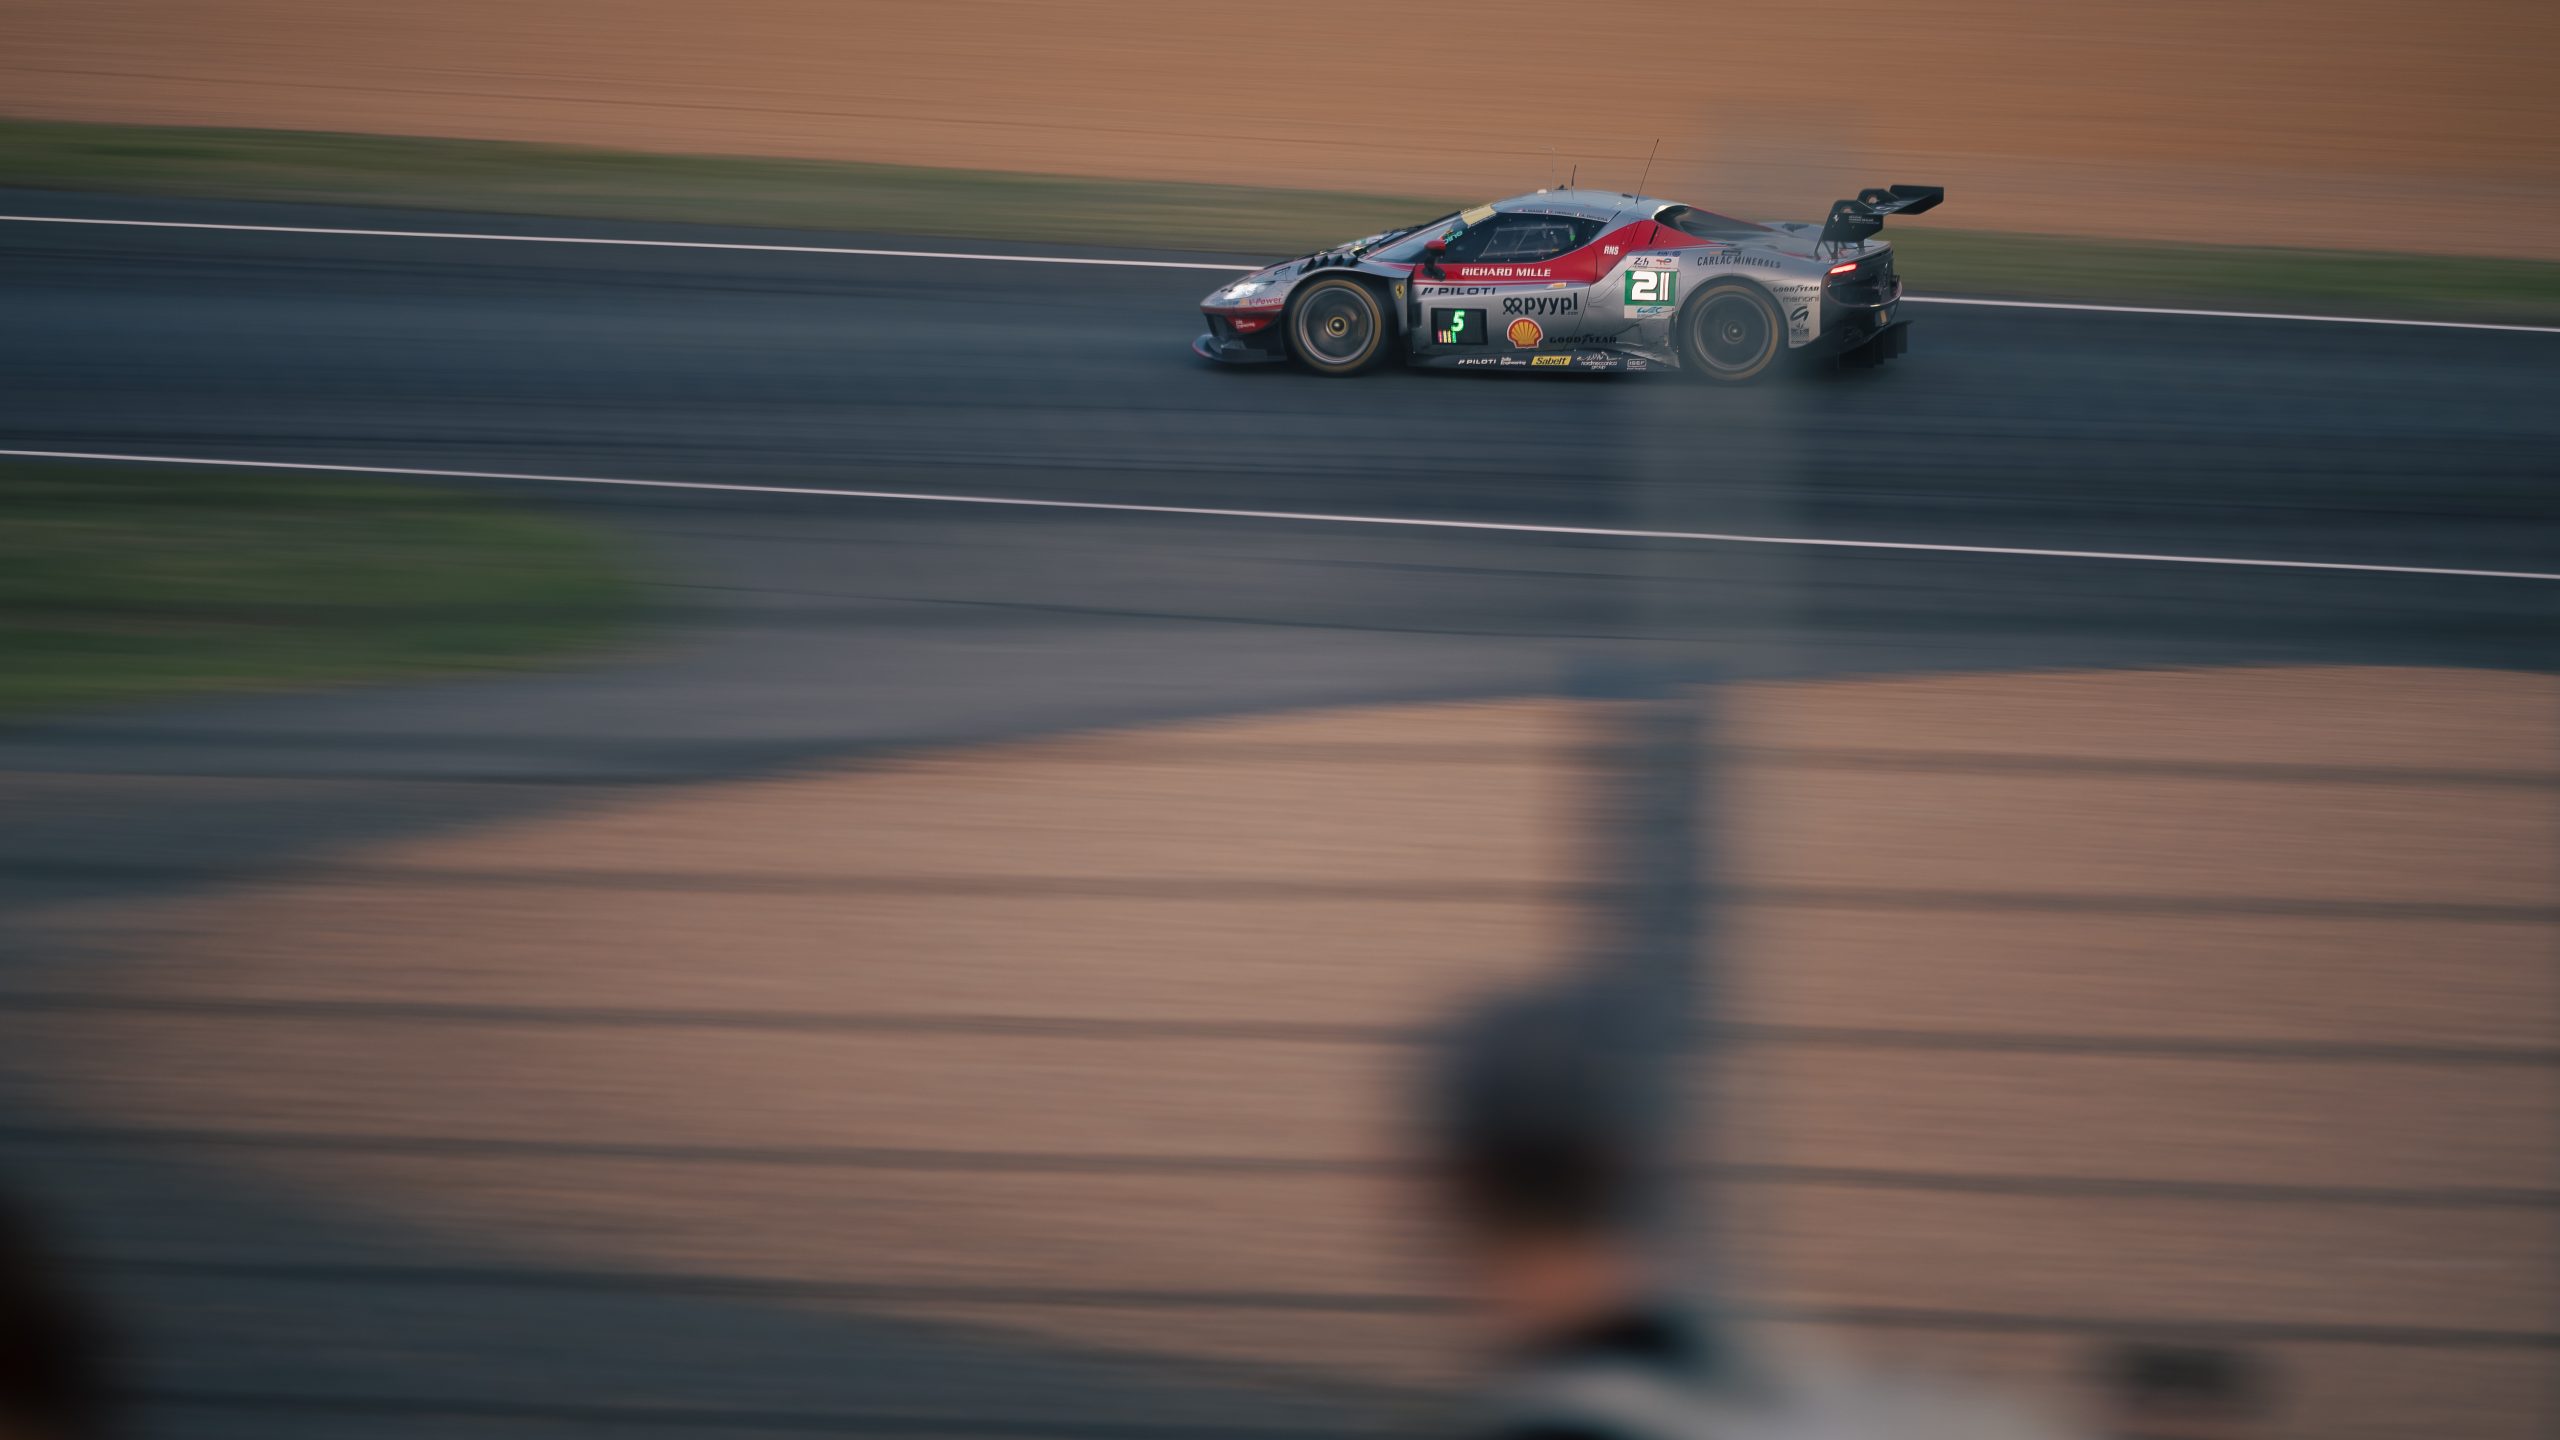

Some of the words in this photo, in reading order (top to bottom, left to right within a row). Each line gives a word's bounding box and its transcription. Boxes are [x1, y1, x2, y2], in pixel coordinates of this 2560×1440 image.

[1603, 245, 1619, 255] RNS
[1697, 255, 1732, 266] CARLAC
[1734, 255, 1781, 269] MINERALS
[1461, 267, 1512, 277] RICHARD
[1516, 268, 1551, 277] MILLE
[1438, 287, 1496, 295] PILOTI
[1631, 270, 1670, 301] 21
[1524, 292, 1578, 315] pyypl
[1451, 310, 1465, 332] 5
[1536, 357, 1567, 365] Sabelt
